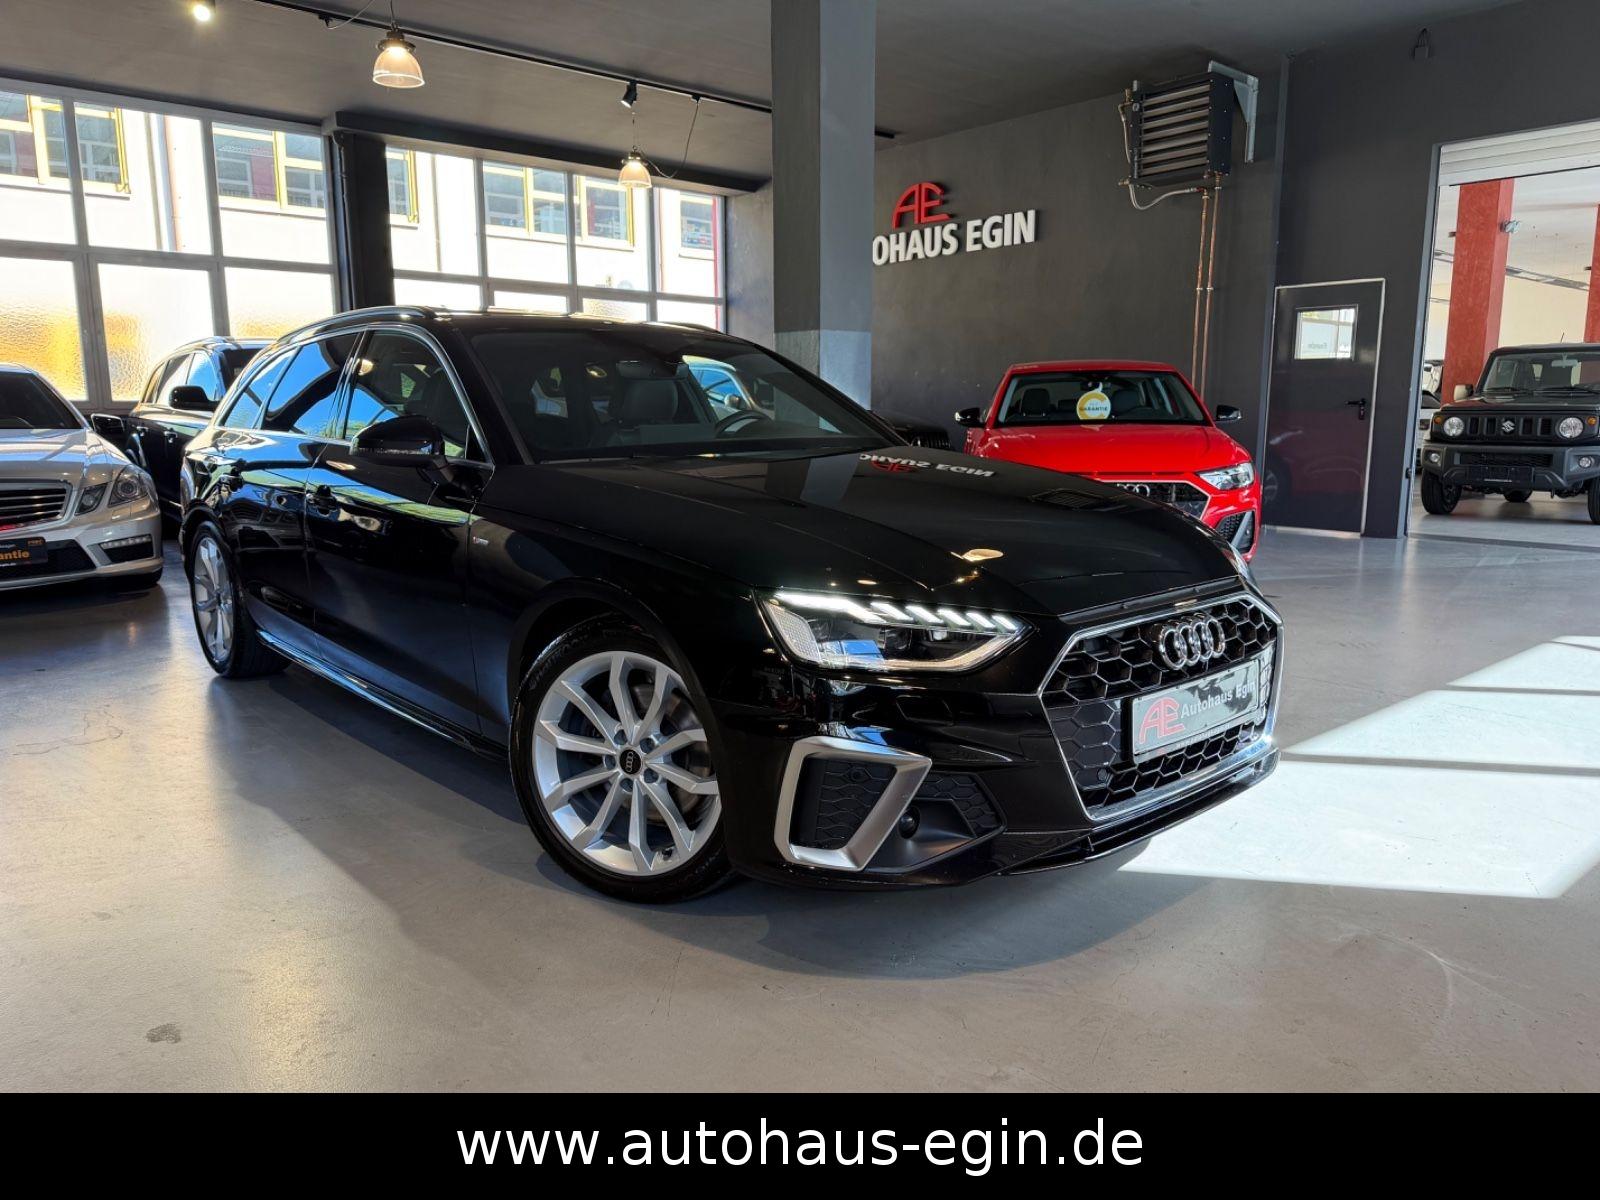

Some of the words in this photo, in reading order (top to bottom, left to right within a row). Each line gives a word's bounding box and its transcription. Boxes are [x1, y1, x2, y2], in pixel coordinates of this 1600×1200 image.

[872, 223, 959, 266] OHAUS
[967, 209, 1036, 252] EGIN
[1181, 689, 1233, 719] Autohaus
[1235, 680, 1256, 699] Egin
